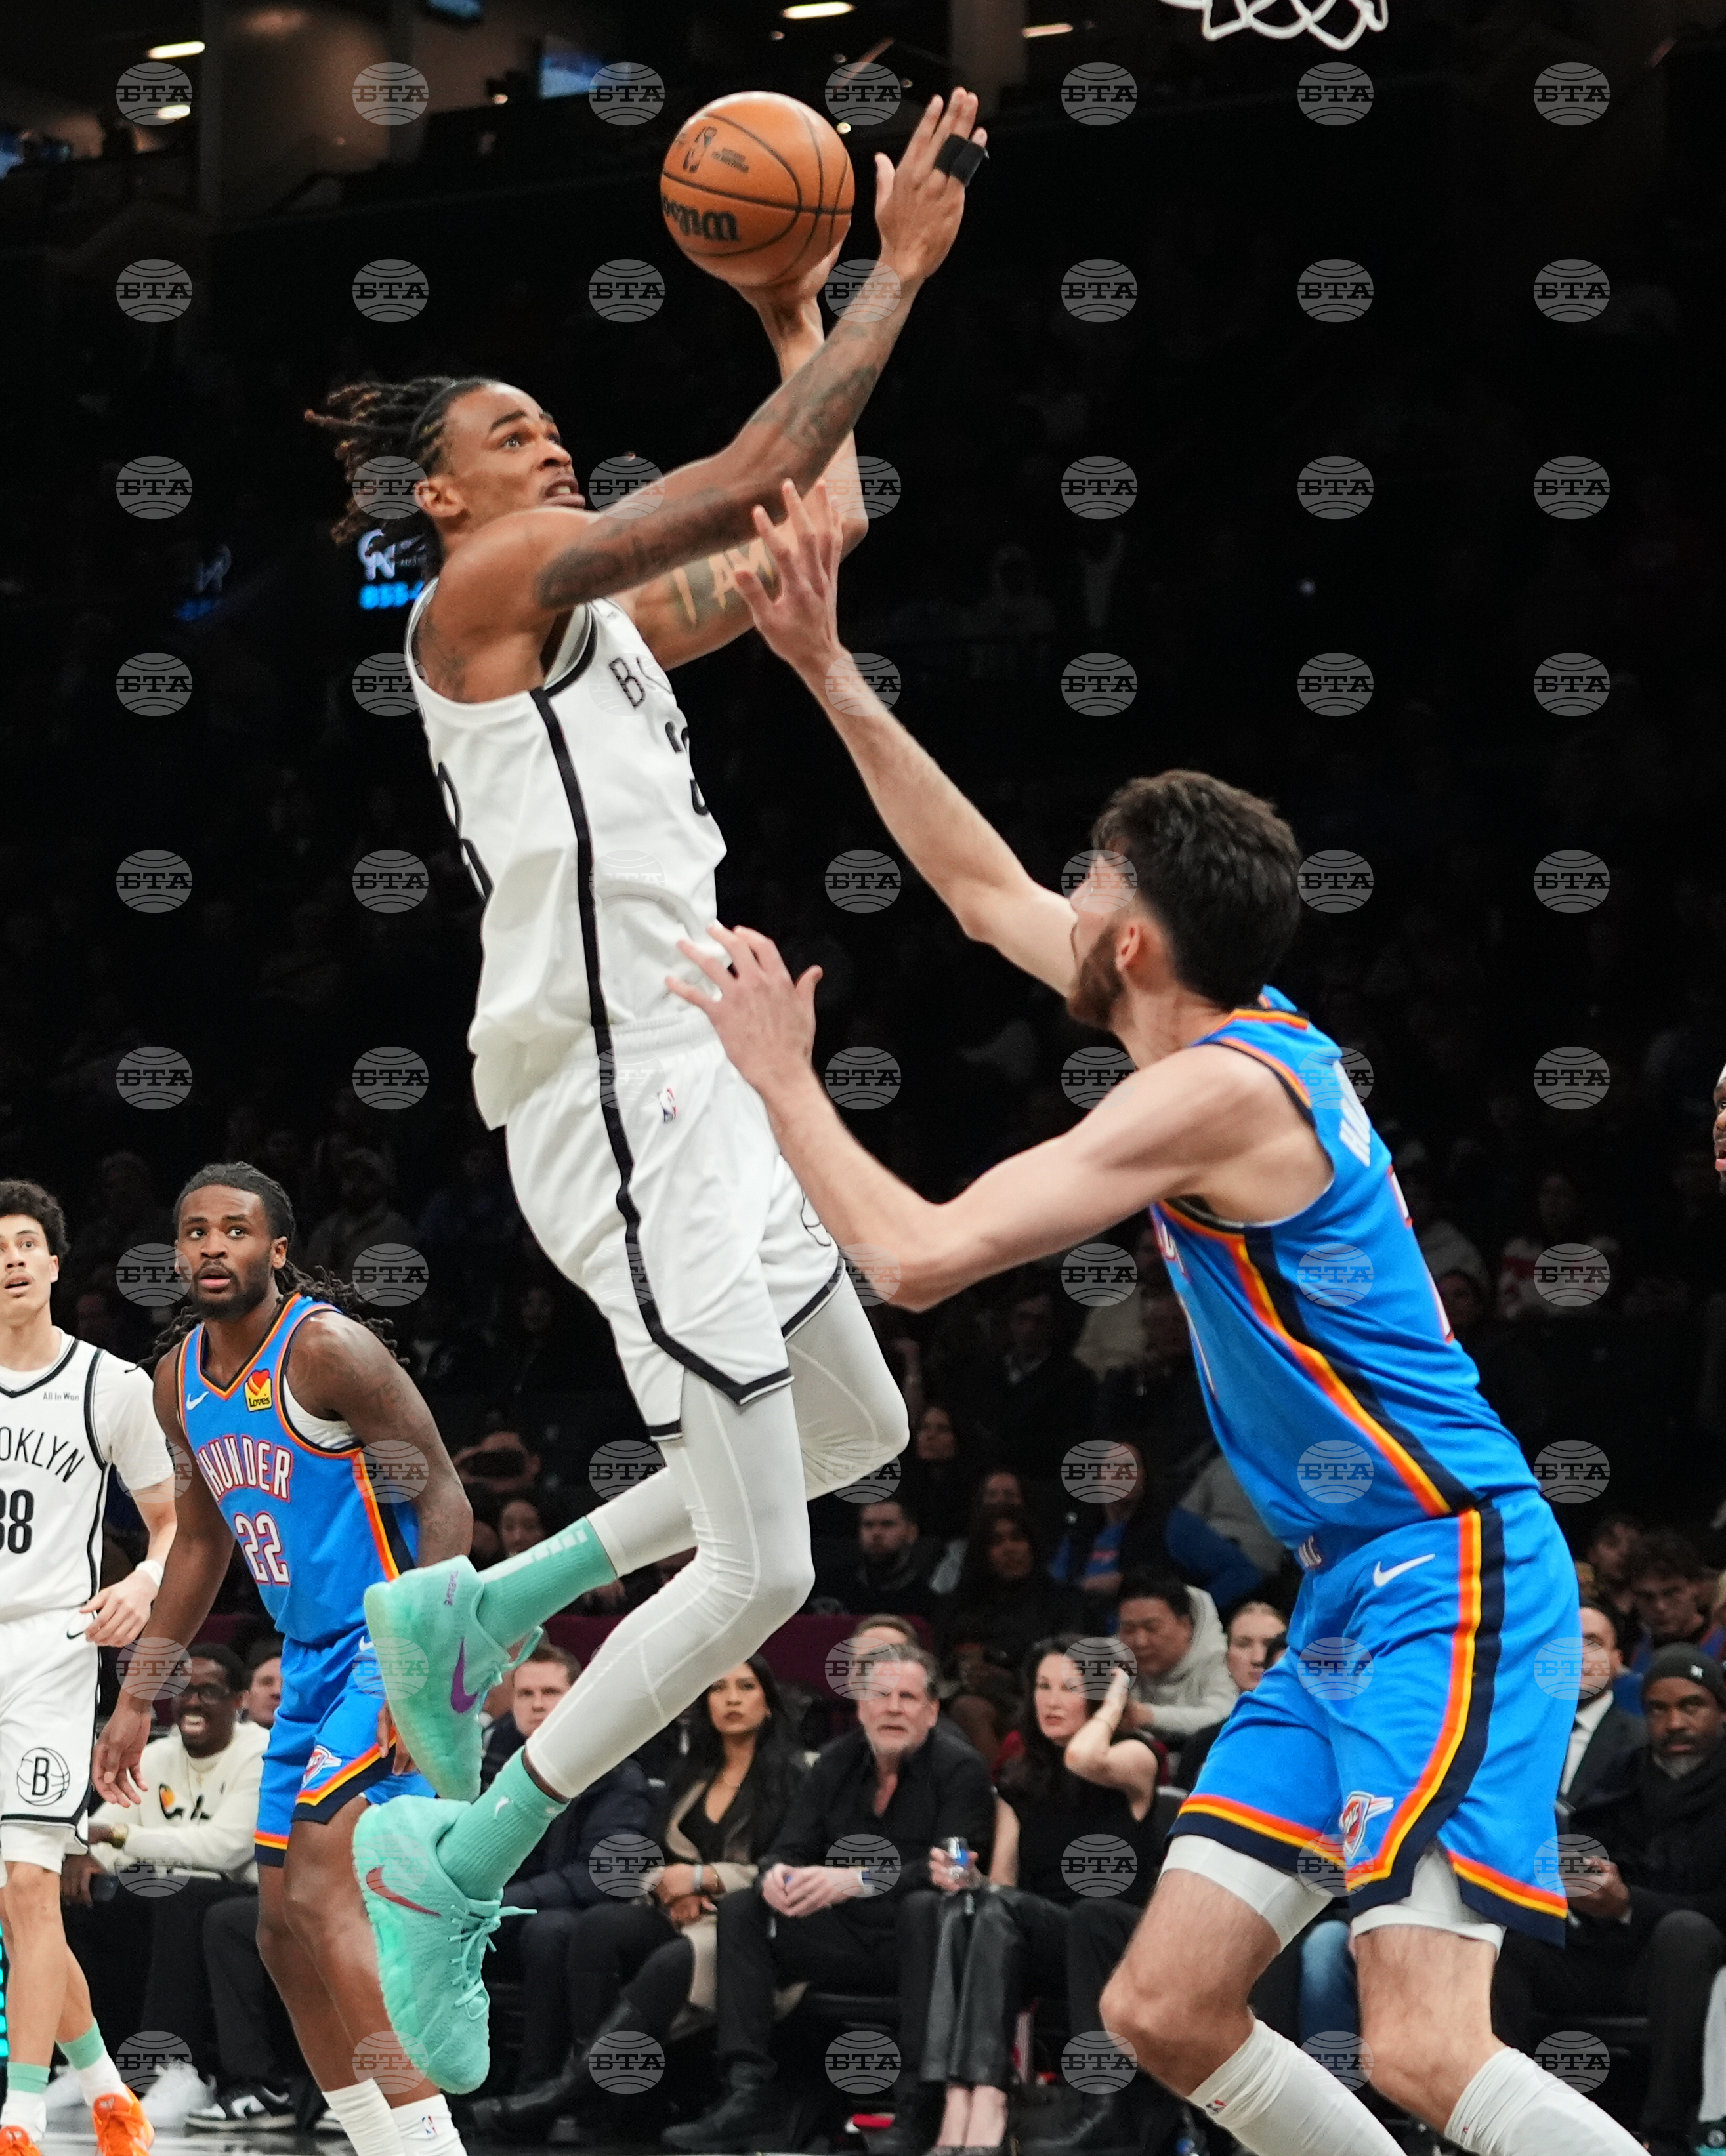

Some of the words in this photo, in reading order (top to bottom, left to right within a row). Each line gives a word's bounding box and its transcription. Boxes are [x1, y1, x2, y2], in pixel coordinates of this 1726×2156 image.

[43, 1392, 53, 1401] All
[54, 1392, 62, 1401] in
[197, 1434, 293, 1503] HUNDER
[0, 1488, 34, 1554] 8
[234, 1512, 291, 1585] 22
[32, 1756, 50, 1796] B
